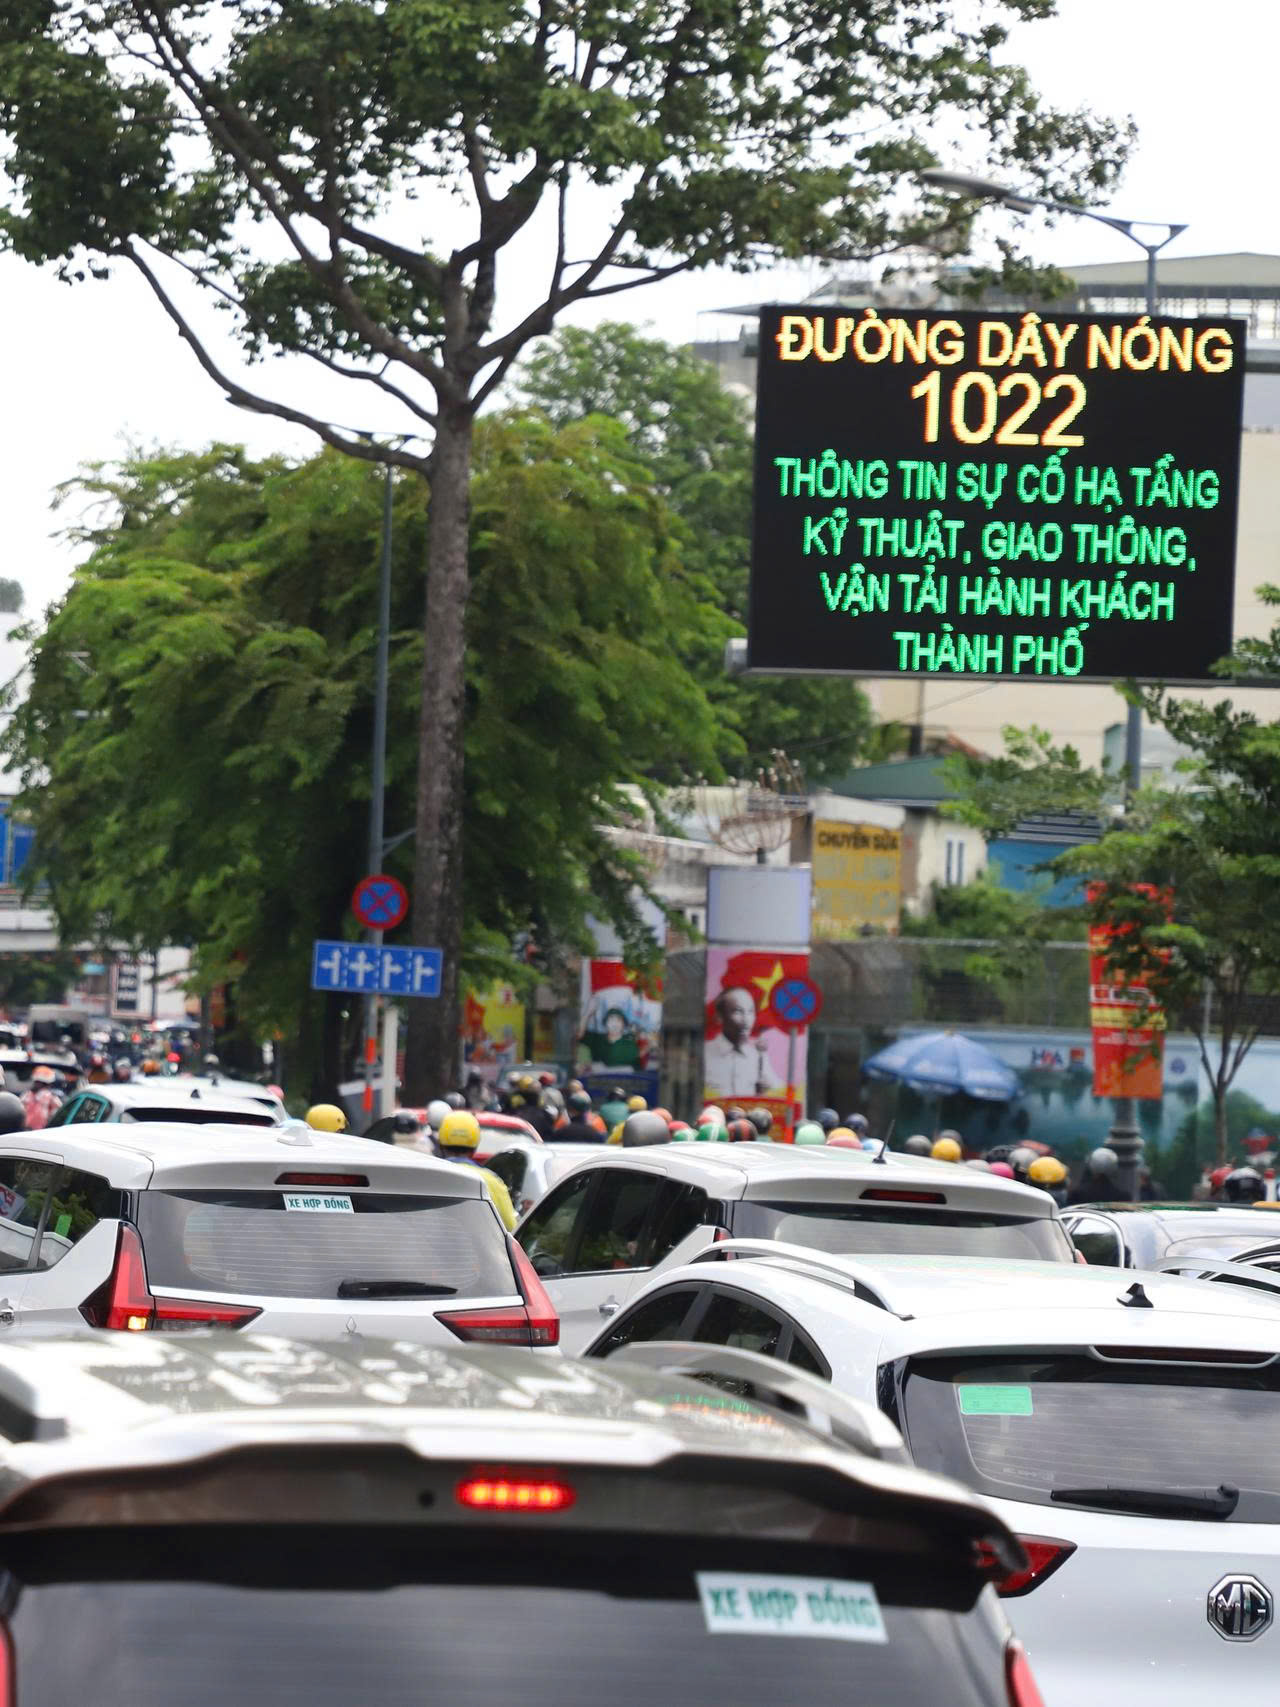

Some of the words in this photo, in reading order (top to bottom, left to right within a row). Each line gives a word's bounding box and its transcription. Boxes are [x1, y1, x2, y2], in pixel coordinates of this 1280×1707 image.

[775, 307, 965, 365] ĐƯỜNG
[977, 311, 1079, 369] DÂY
[1086, 316, 1234, 373] NÓNG
[911, 370, 1087, 447] 1022
[773, 448, 889, 500] THÔNG
[896, 460, 947, 501] TIN
[956, 462, 1008, 510] SỰ
[1016, 447, 1070, 504] CỐ
[1074, 465, 1123, 514] HẠ
[1129, 453, 1220, 509] TẦNG
[803, 506, 850, 556] KỸ
[981, 521, 1064, 562] GIAO
[1071, 514, 1196, 572] THÔNG,
[819, 562, 890, 617] VẬN
[897, 564, 948, 614] TẢI
[959, 566, 1051, 617] HÀNH
[1059, 570, 1175, 622] KHÁCH
[892, 622, 1004, 674] THÀNH
[1012, 622, 1090, 676] PHỐ
[287, 1198, 301, 1209] XE
[302, 1198, 322, 1210] HỢP
[707, 1586, 742, 1620] XE
[746, 1586, 798, 1631] HỢP
[1215, 1582, 1268, 1636] MG
